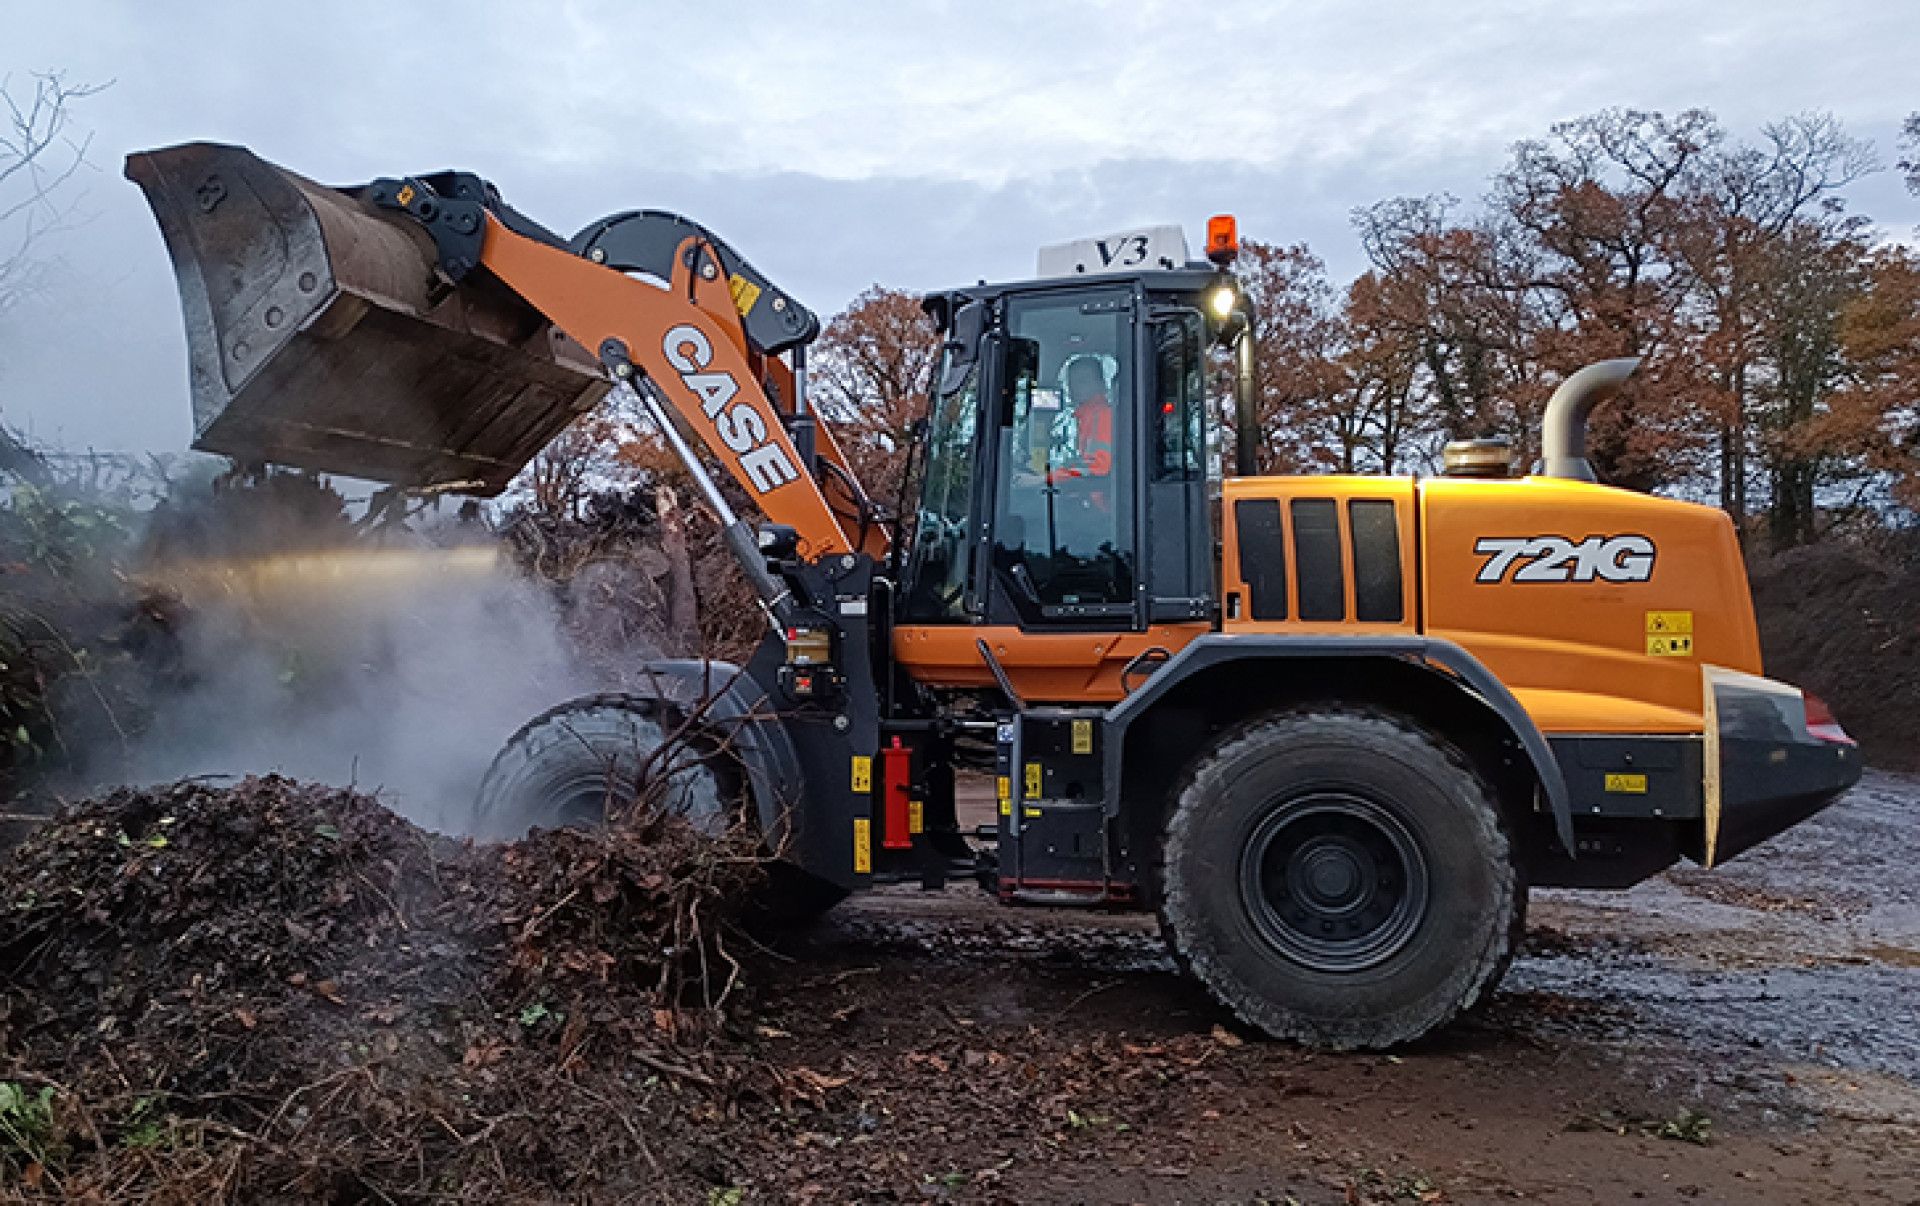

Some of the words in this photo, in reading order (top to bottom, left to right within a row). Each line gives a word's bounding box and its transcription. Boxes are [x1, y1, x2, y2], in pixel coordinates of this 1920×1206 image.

[1096, 237, 1149, 267] V3
[662, 324, 800, 493] CASE
[1474, 534, 1656, 583] 721G
